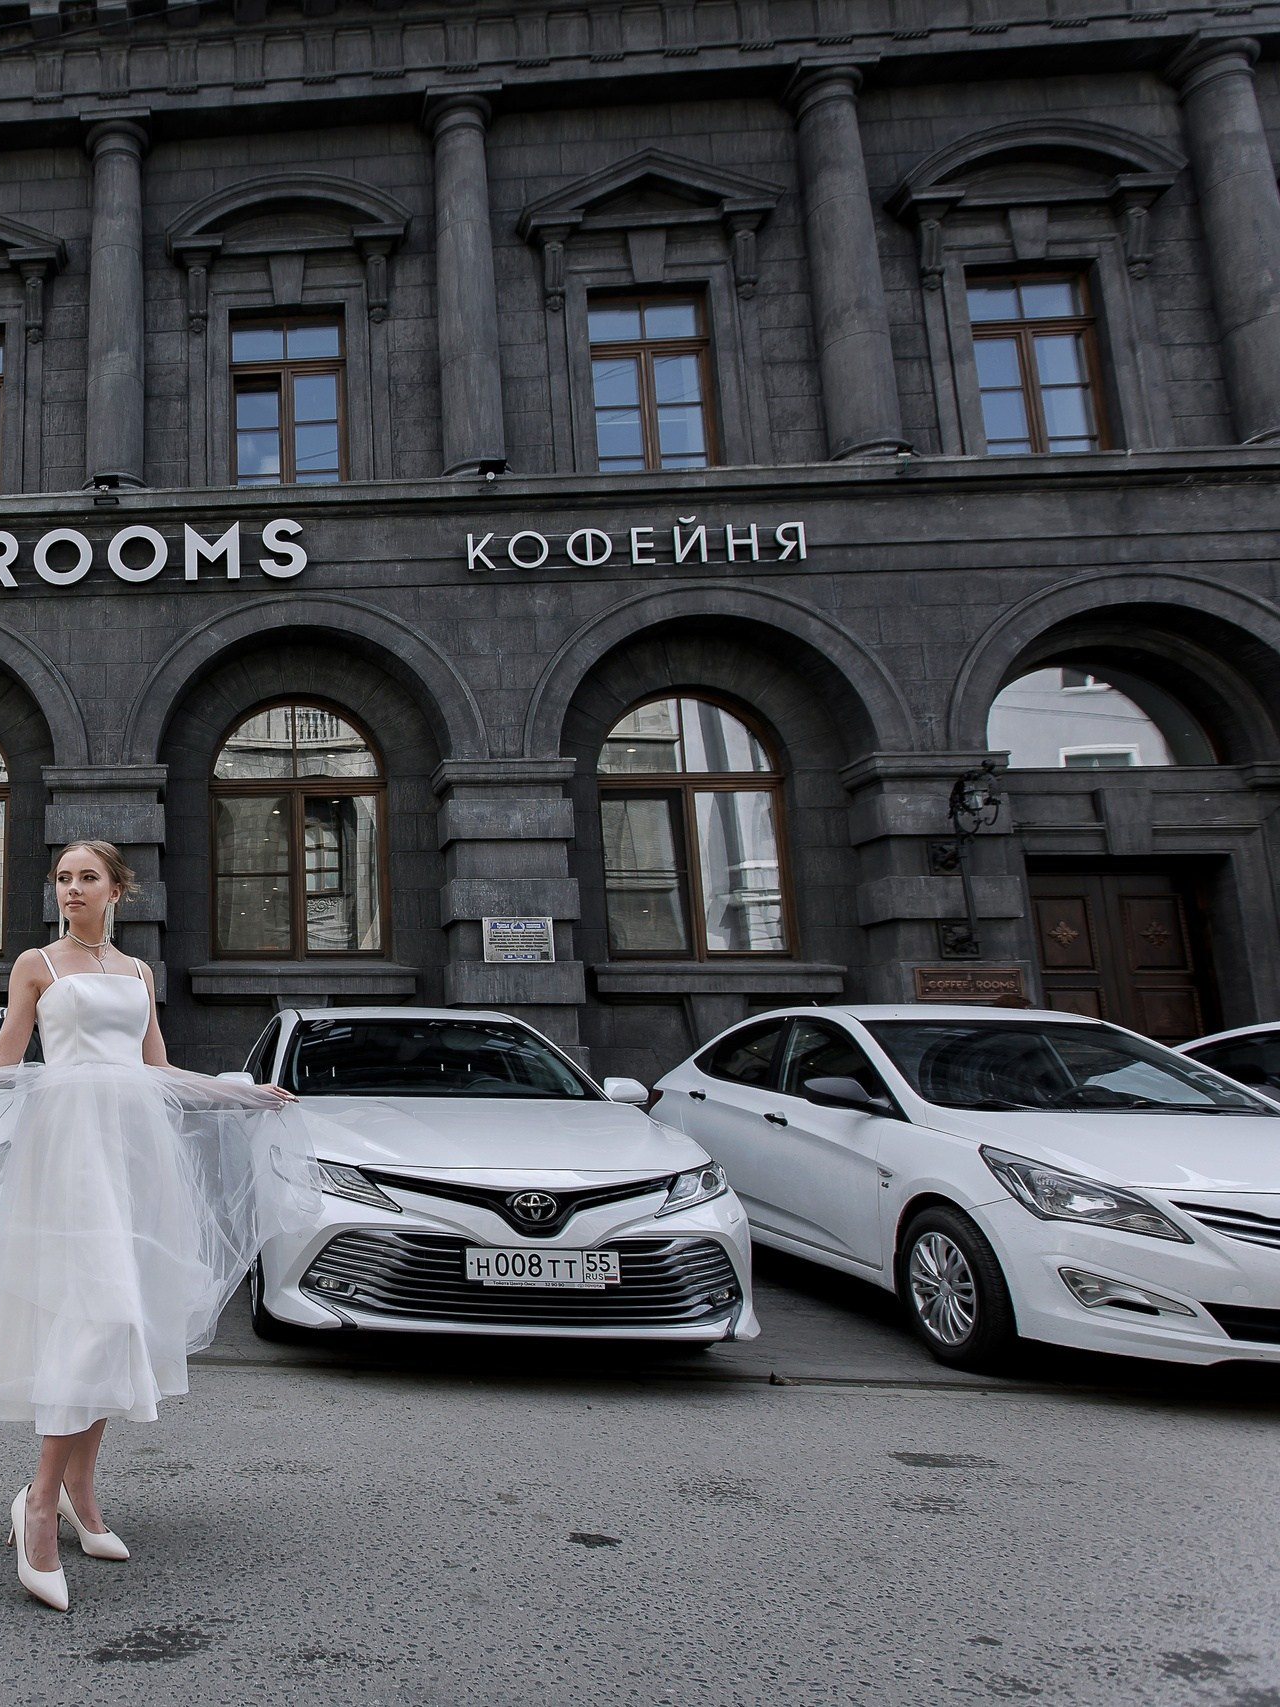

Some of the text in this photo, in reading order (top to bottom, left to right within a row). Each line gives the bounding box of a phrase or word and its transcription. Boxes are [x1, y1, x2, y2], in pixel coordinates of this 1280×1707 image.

[466, 515, 809, 571] КОФЕЙНЯ
[928, 980, 1016, 989] COFFEE ROOMS
[585, 1253, 611, 1272] 55
[585, 1272, 604, 1281] RUS
